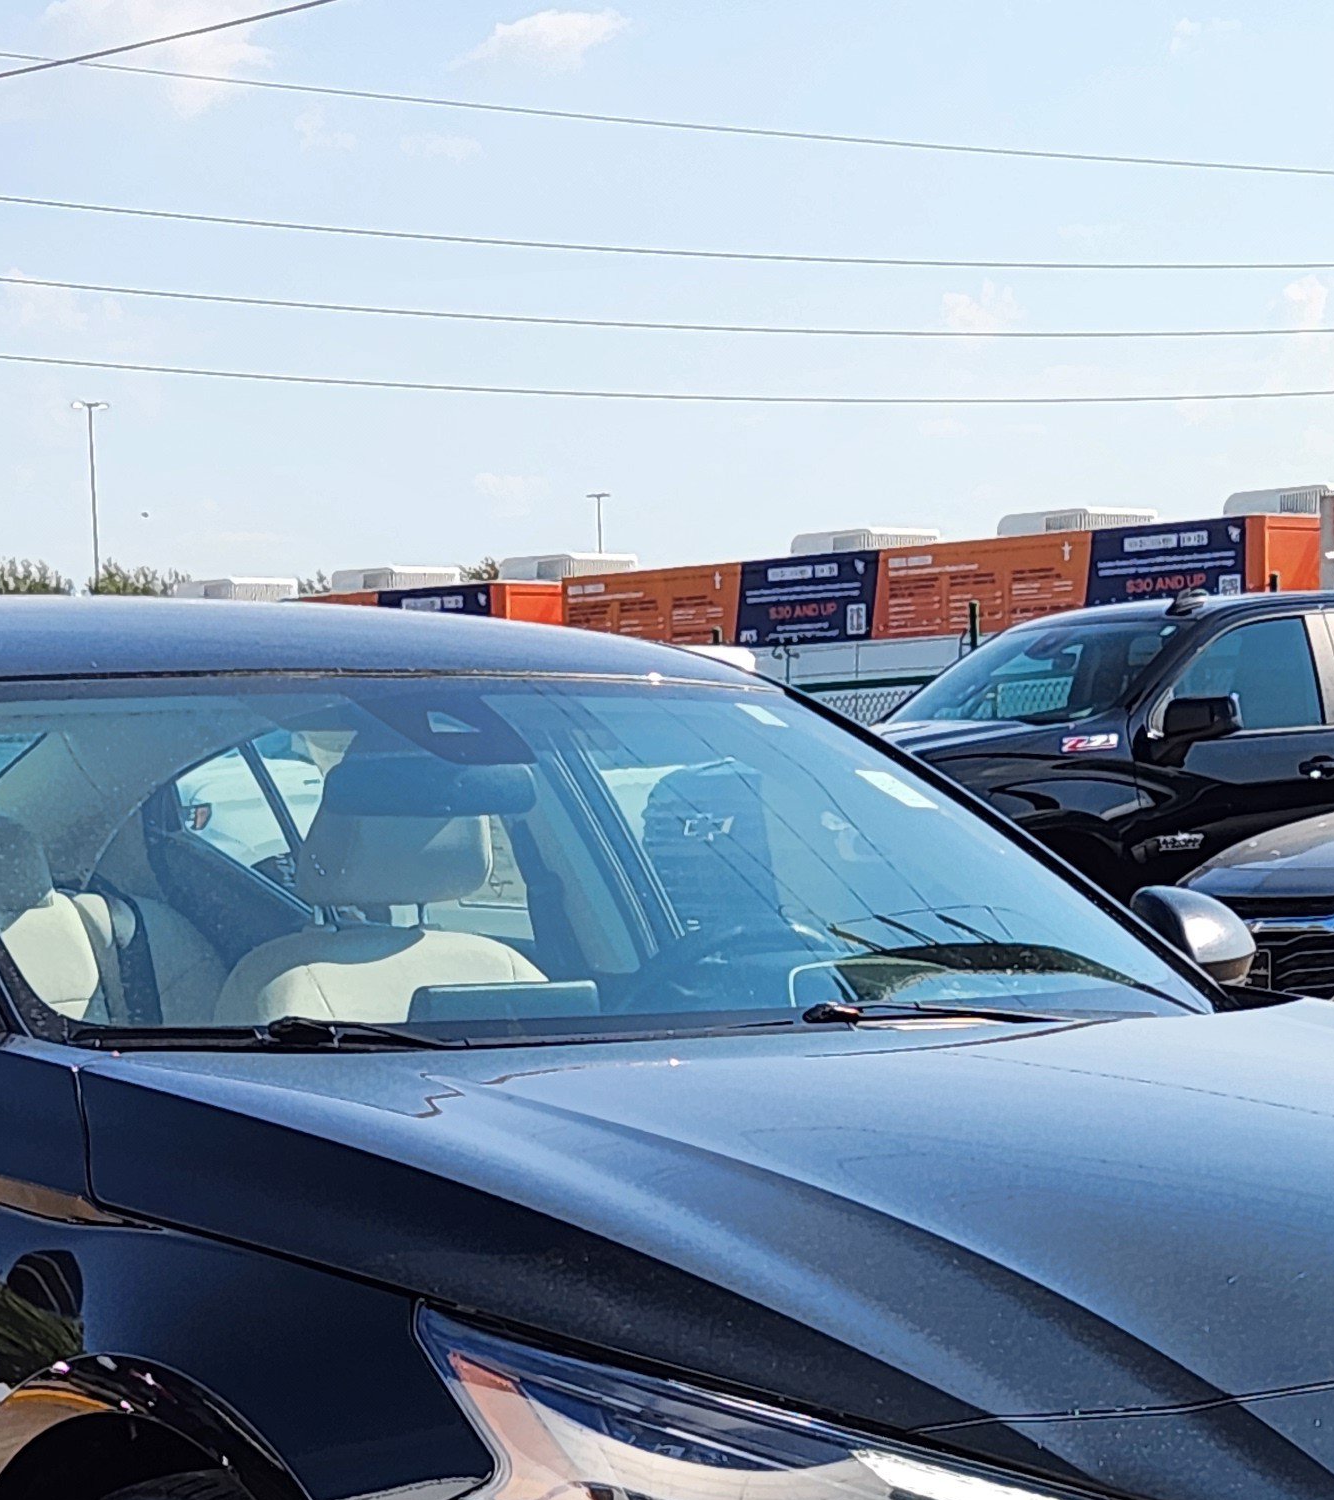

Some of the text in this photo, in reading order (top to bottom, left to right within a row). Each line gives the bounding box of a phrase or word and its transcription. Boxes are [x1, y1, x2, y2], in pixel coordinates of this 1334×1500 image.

[1125, 572, 1206, 594] $30 AND UP
